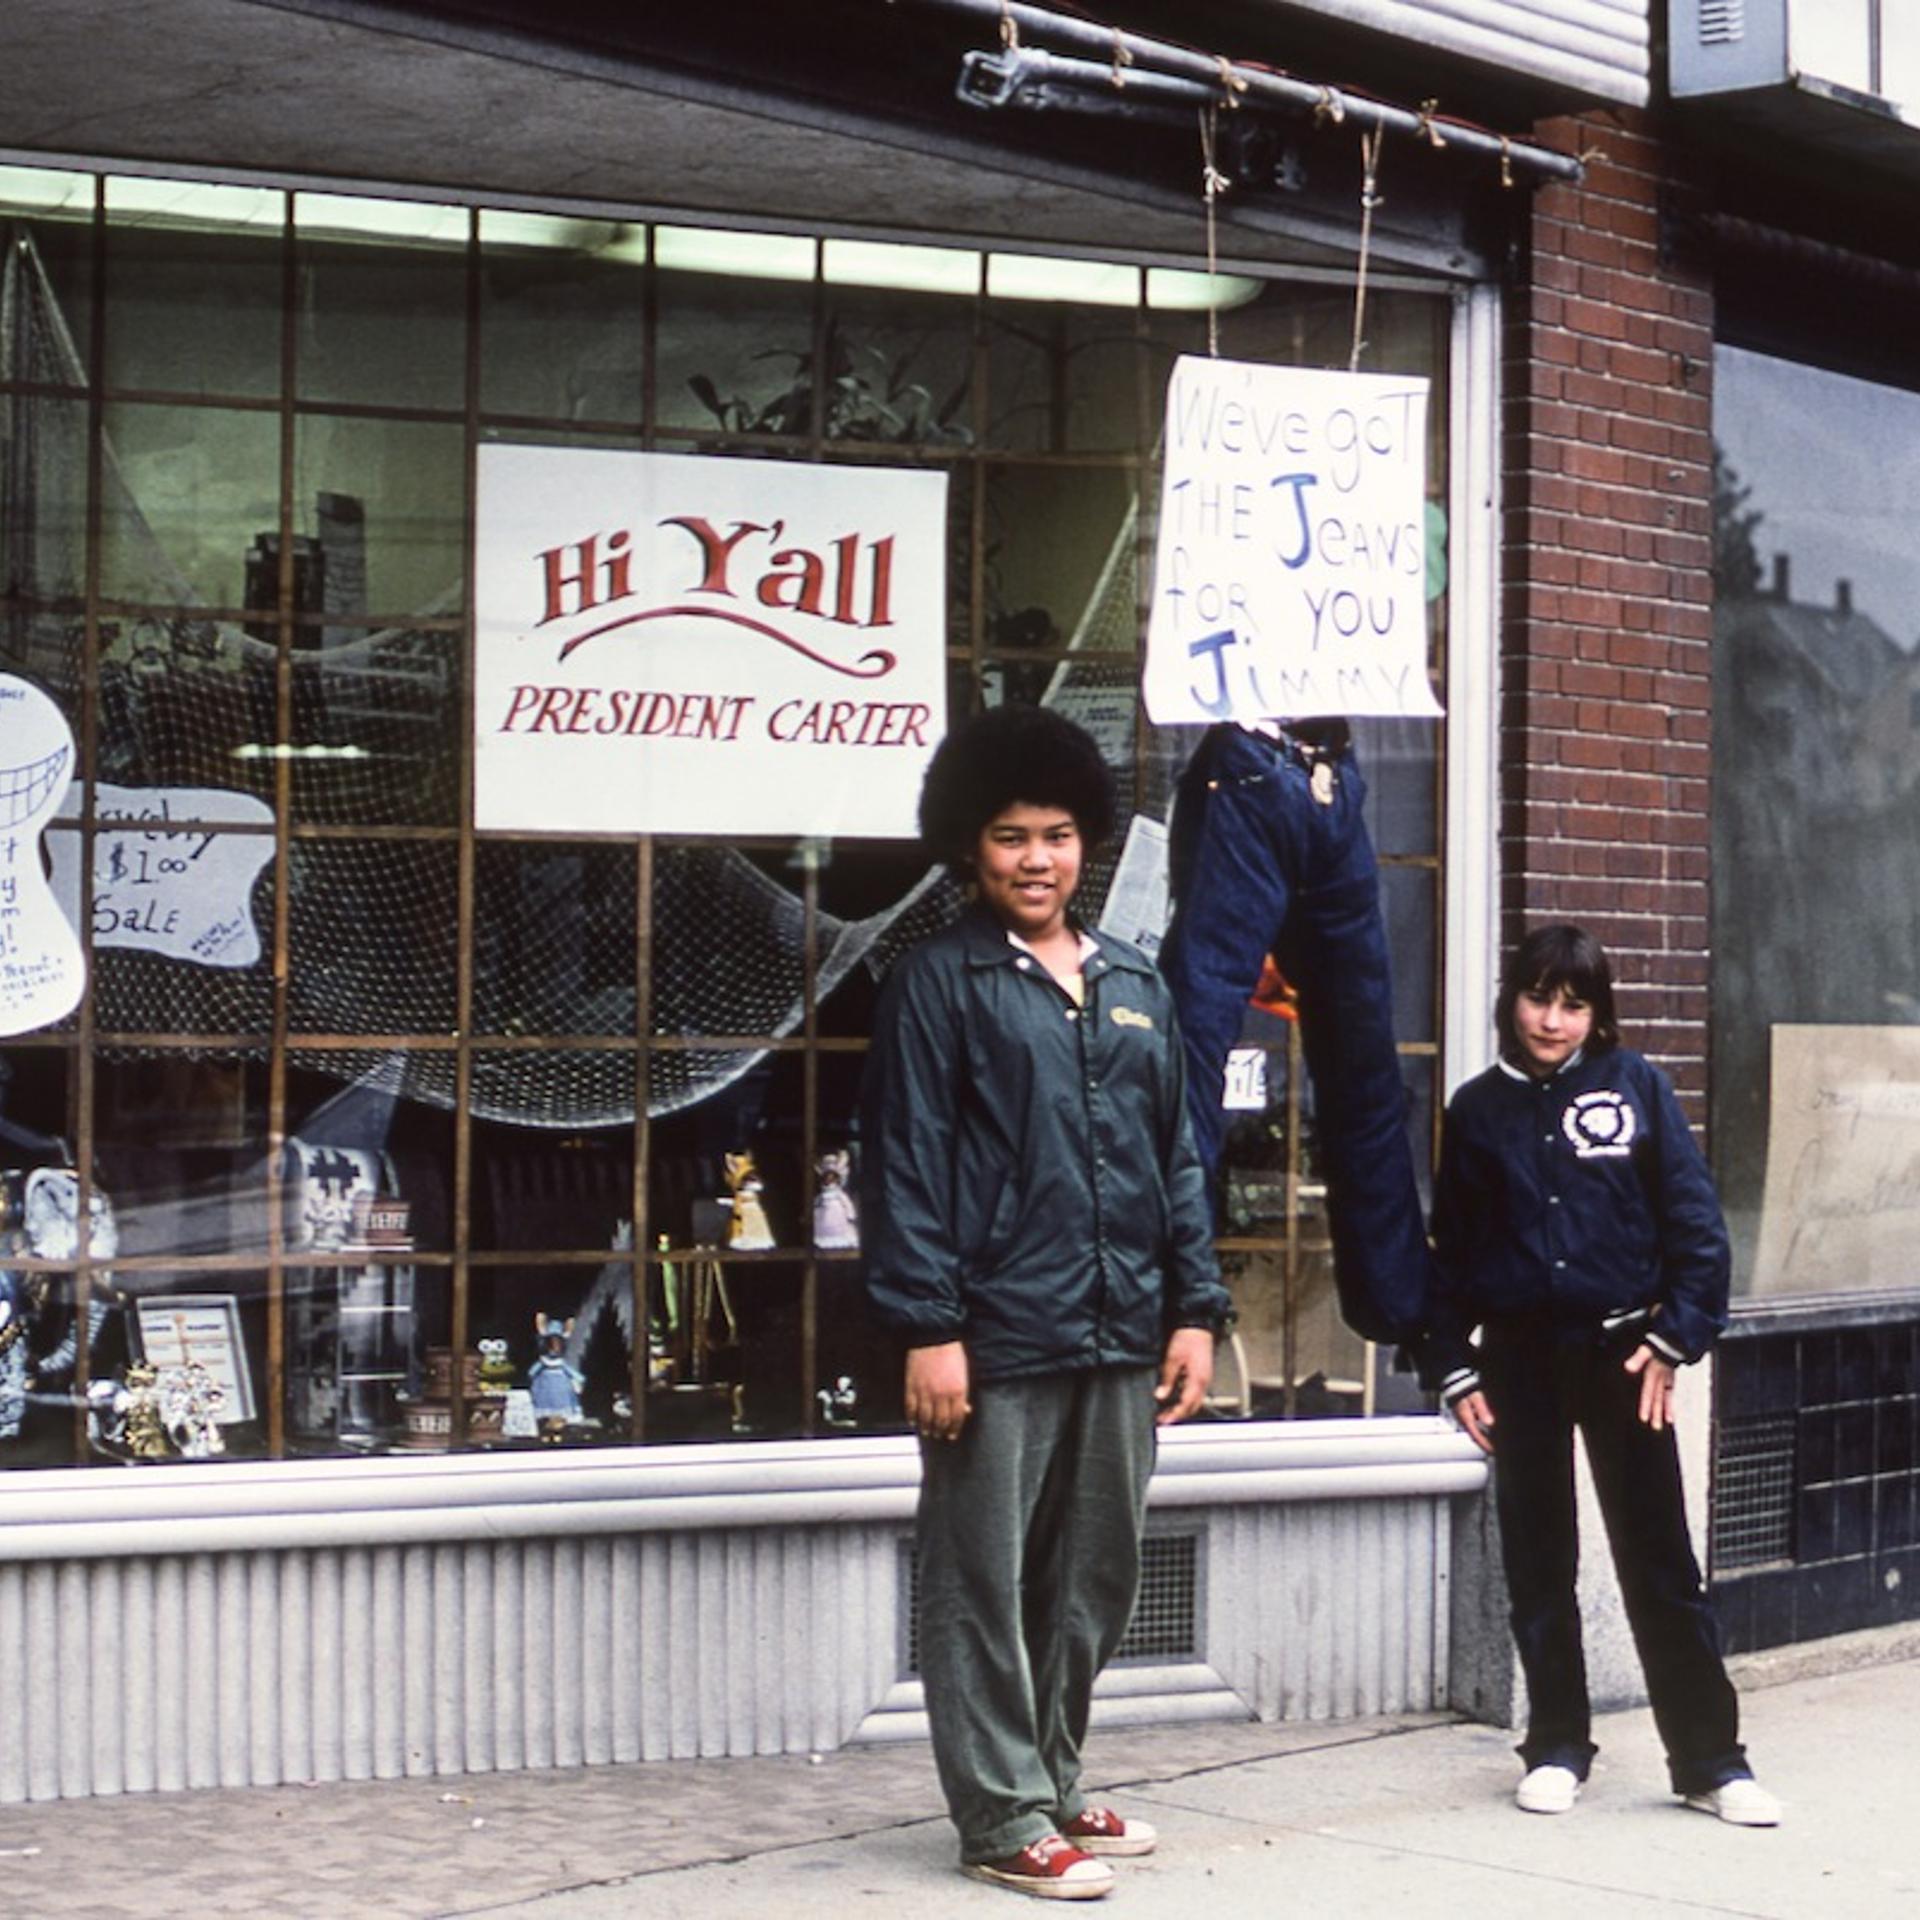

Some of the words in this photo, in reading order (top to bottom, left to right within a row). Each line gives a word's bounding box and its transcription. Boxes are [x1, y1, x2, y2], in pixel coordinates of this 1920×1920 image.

[1171, 478, 1253, 540] THE
[533, 530, 638, 628] Hi
[656, 515, 897, 629] Y'all
[497, 684, 756, 742] PRESIDENT
[767, 699, 932, 747] CARTER
